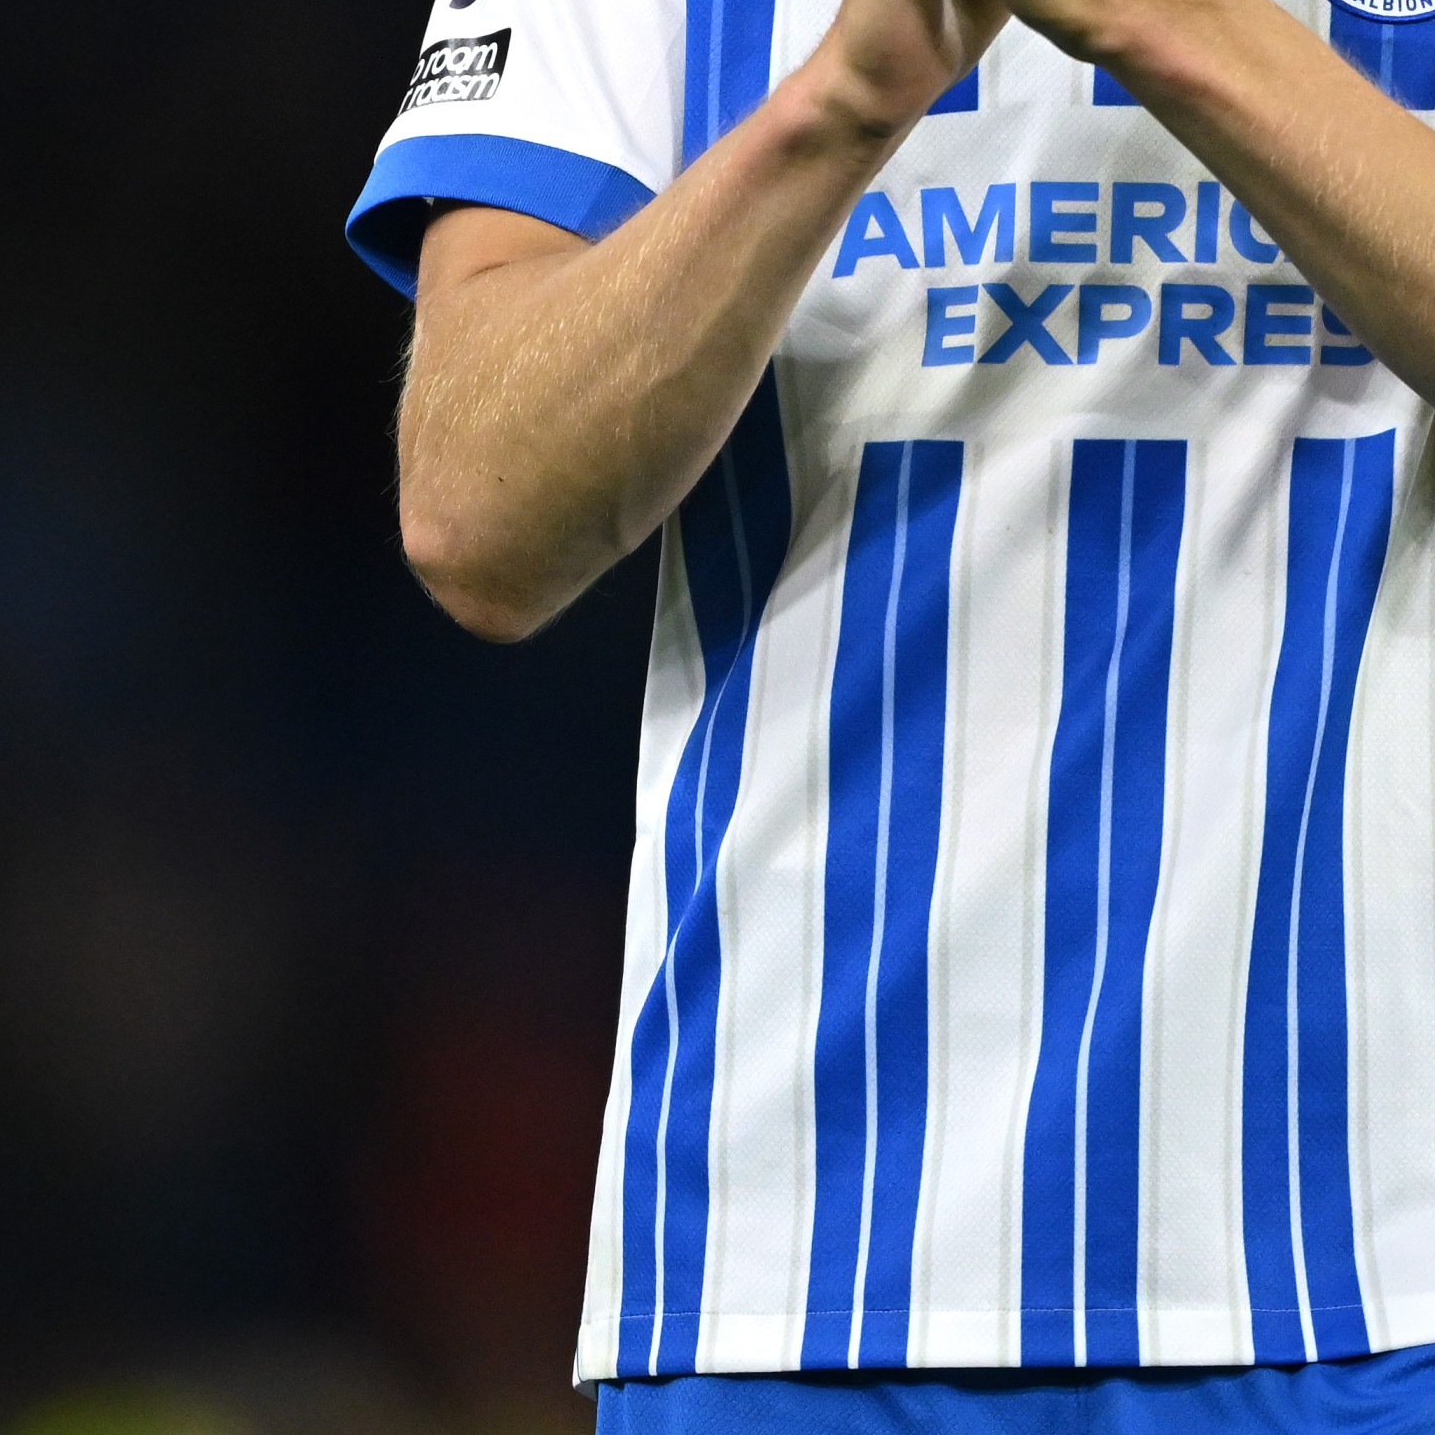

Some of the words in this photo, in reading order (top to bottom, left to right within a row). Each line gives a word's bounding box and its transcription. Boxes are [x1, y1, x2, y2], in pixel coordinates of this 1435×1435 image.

[422, 42, 498, 80] room
[406, 73, 500, 110] racism
[921, 283, 1376, 367] EXPRES
